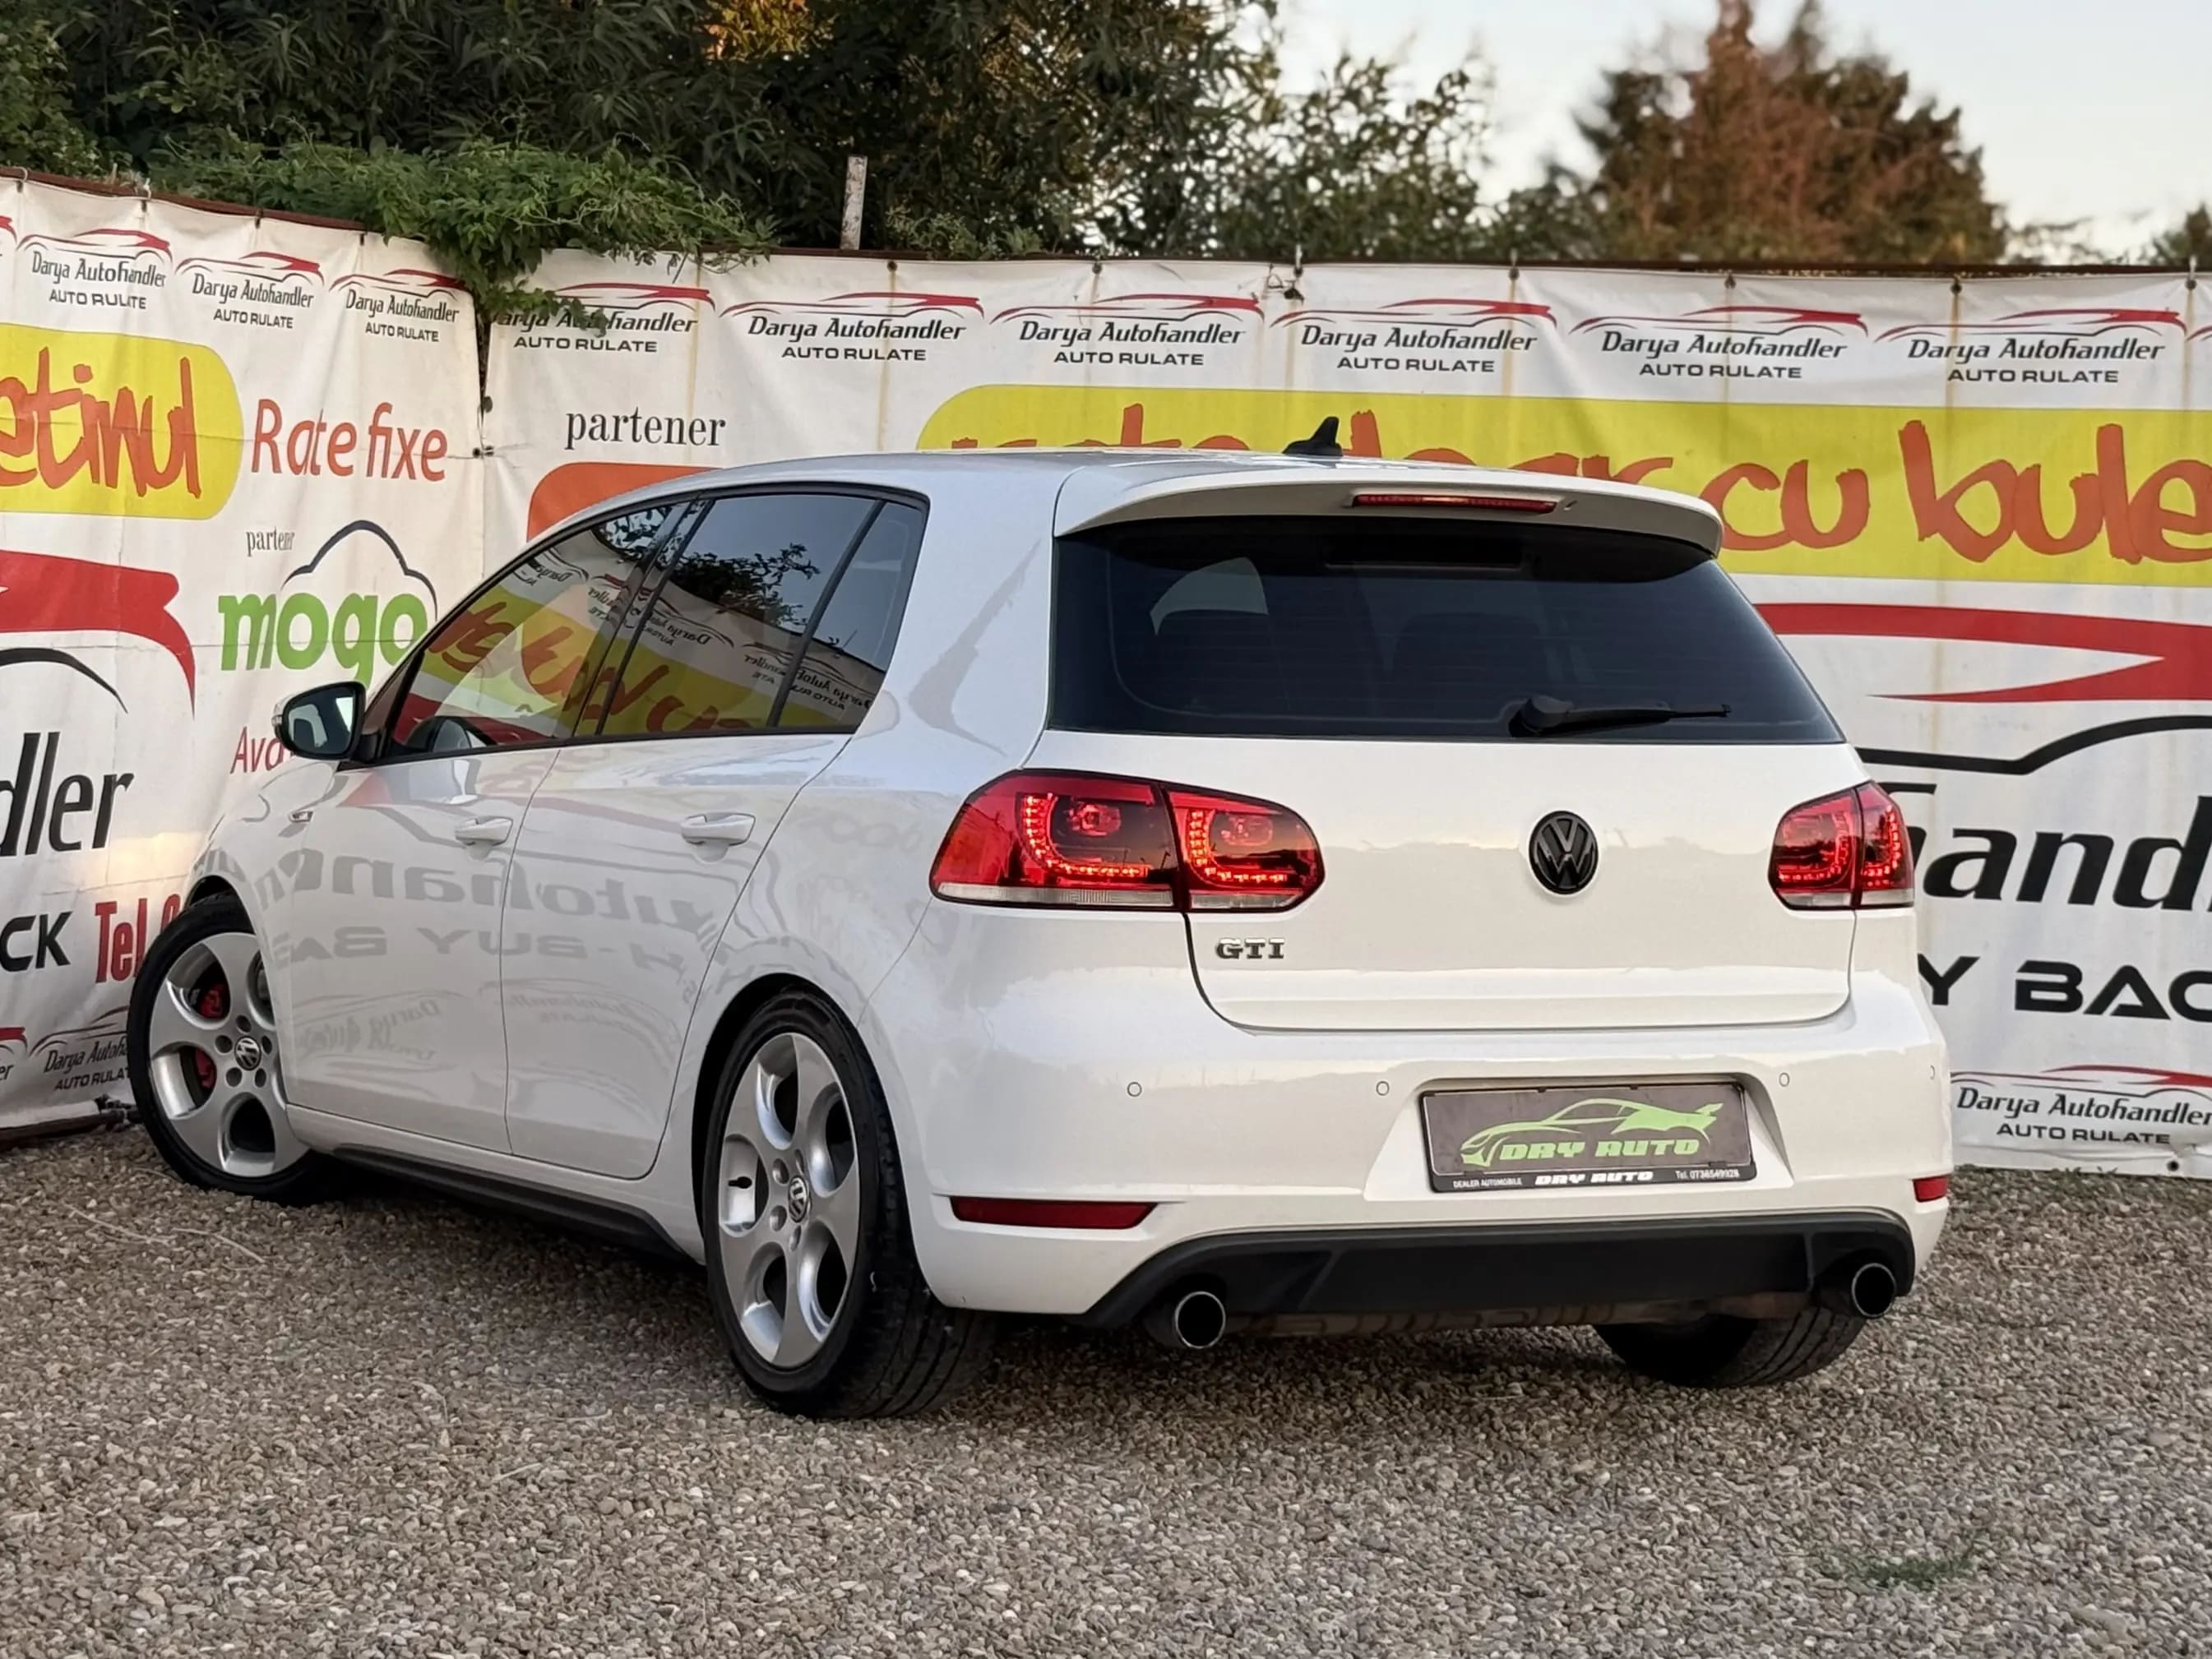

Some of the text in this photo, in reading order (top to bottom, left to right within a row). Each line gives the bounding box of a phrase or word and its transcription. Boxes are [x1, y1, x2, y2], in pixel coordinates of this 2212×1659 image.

[32, 251, 69, 284] Darya
[49, 290, 87, 305] AUTO
[192, 273, 314, 308] Darya Autohandler
[345, 289, 460, 323] Darya Autohandler
[214, 308, 294, 329] AUTO RULATE
[493, 312, 549, 332] arya
[747, 316, 965, 342] Darya Autohandler
[365, 322, 439, 342] AUTO RULATE
[1020, 321, 1246, 347] Darya Autohandler
[1301, 325, 1537, 353] Darya Autohandler
[514, 336, 657, 353] AUTO RULATE
[781, 347, 926, 362] AUTO RULATE
[1601, 330, 1848, 359] Darya Autohandler
[1907, 337, 2166, 365] Darya Autohandler
[1053, 351, 1204, 366] AUTO RULATE
[1337, 357, 1495, 372] AUTO RULATE
[1639, 363, 1802, 379] AUTO RULATE
[1947, 368, 2119, 384] AUTO RULATE
[251, 398, 448, 481] Rate fixe
[565, 407, 726, 451] partener
[1697, 419, 2212, 565] cu bule
[218, 592, 428, 687] mogo
[230, 726, 287, 774] Ava
[1215, 937, 1285, 960] GTI
[54, 1067, 131, 1091] AUTO RULAT
[1956, 1087, 2040, 1119] Darya
[1997, 1123, 2171, 1145] AUTO RULATE
[1499, 1139, 1700, 1160] DRY AUTO
[1453, 1177, 1523, 1188] DEALER AUTOMOBILE
[1534, 1171, 1654, 1185] DRY AUTO
